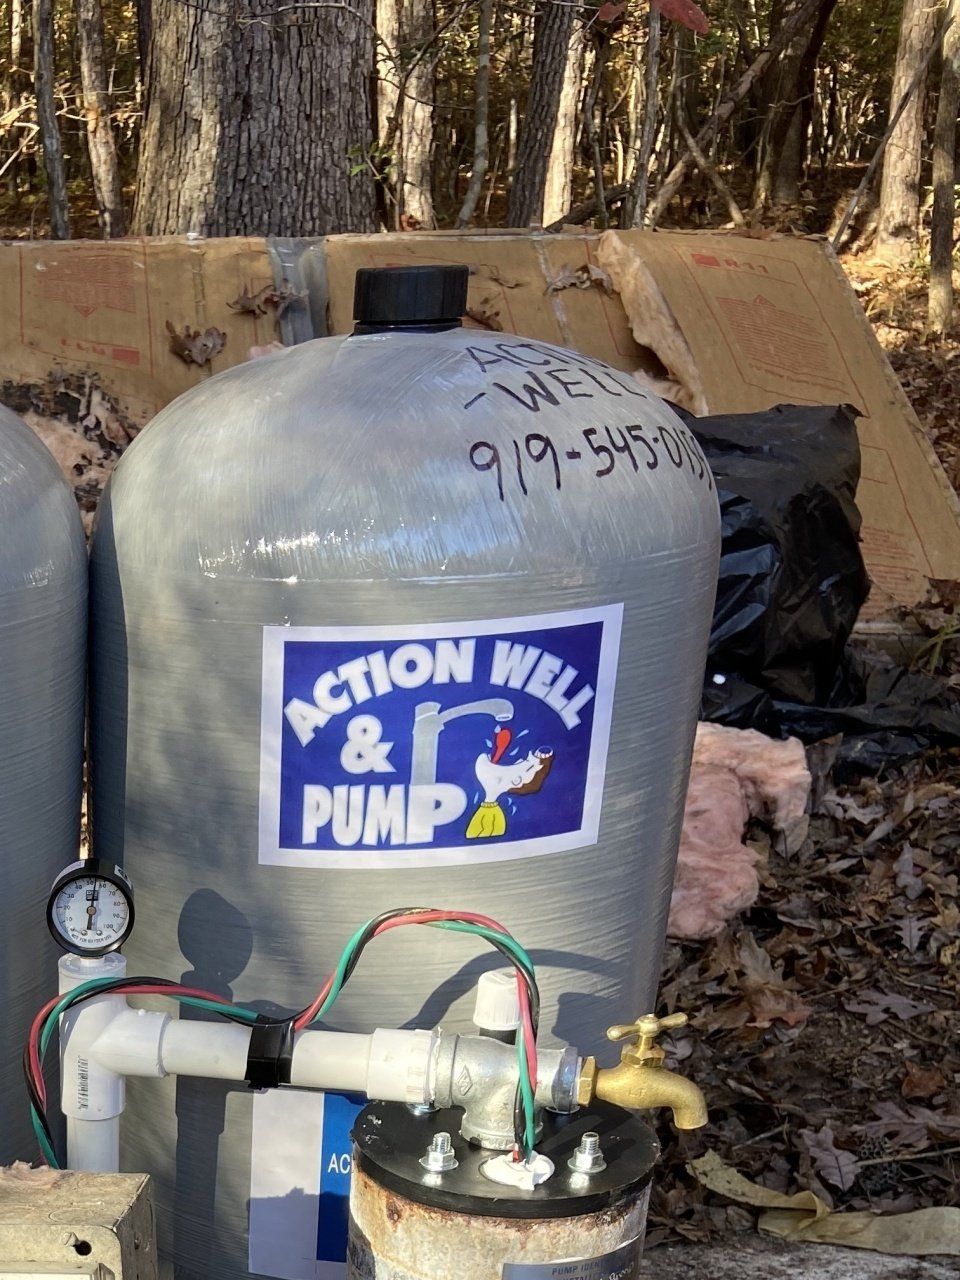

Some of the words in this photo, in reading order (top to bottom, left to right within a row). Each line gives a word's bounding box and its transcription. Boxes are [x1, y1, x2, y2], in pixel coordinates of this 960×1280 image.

[284, 638, 476, 748] ACTION
[490, 639, 595, 731] WELL
[340, 714, 397, 775] &
[302, 782, 467, 847] PUMP
[328, 1152, 351, 1174] AC
[552, 1265, 578, 1275] PUMP
